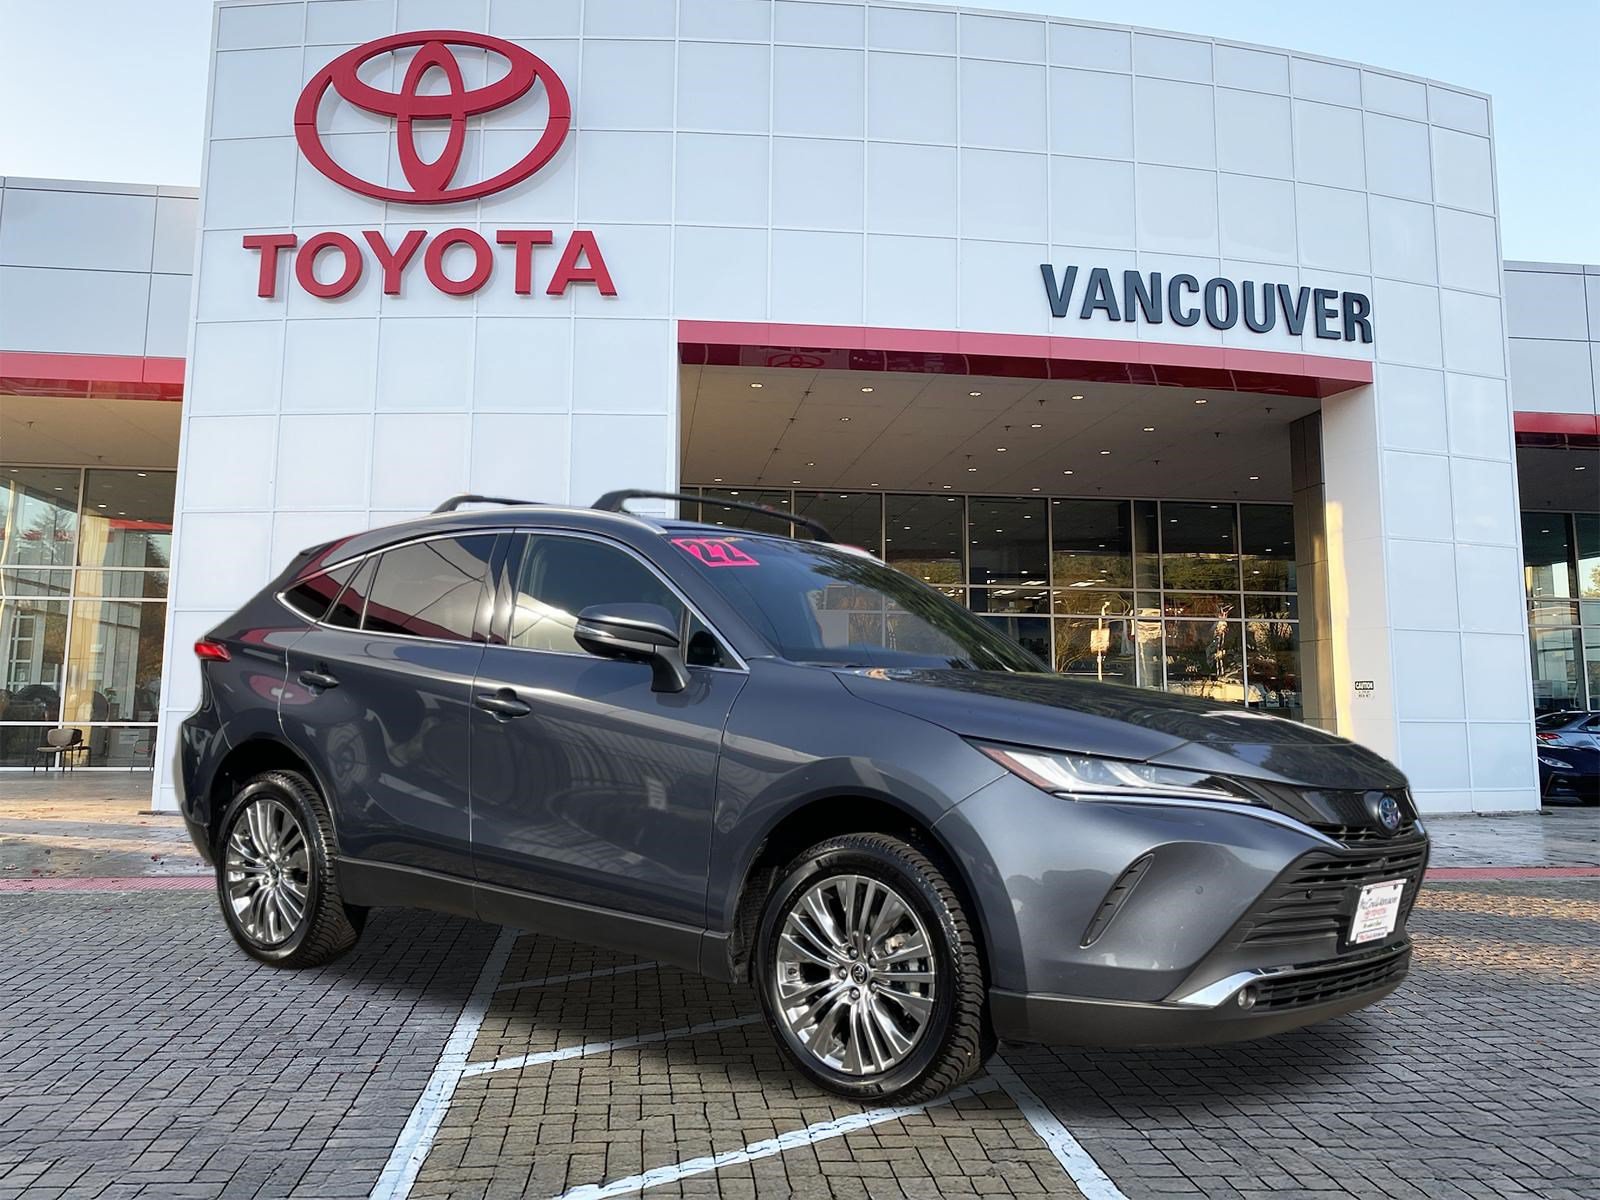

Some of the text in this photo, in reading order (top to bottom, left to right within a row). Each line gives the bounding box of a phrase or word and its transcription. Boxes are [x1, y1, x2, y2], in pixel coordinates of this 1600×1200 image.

[243, 228, 617, 298] TOYOTA
[1040, 264, 1373, 343] VANCOUVER
[679, 540, 750, 562] 22
